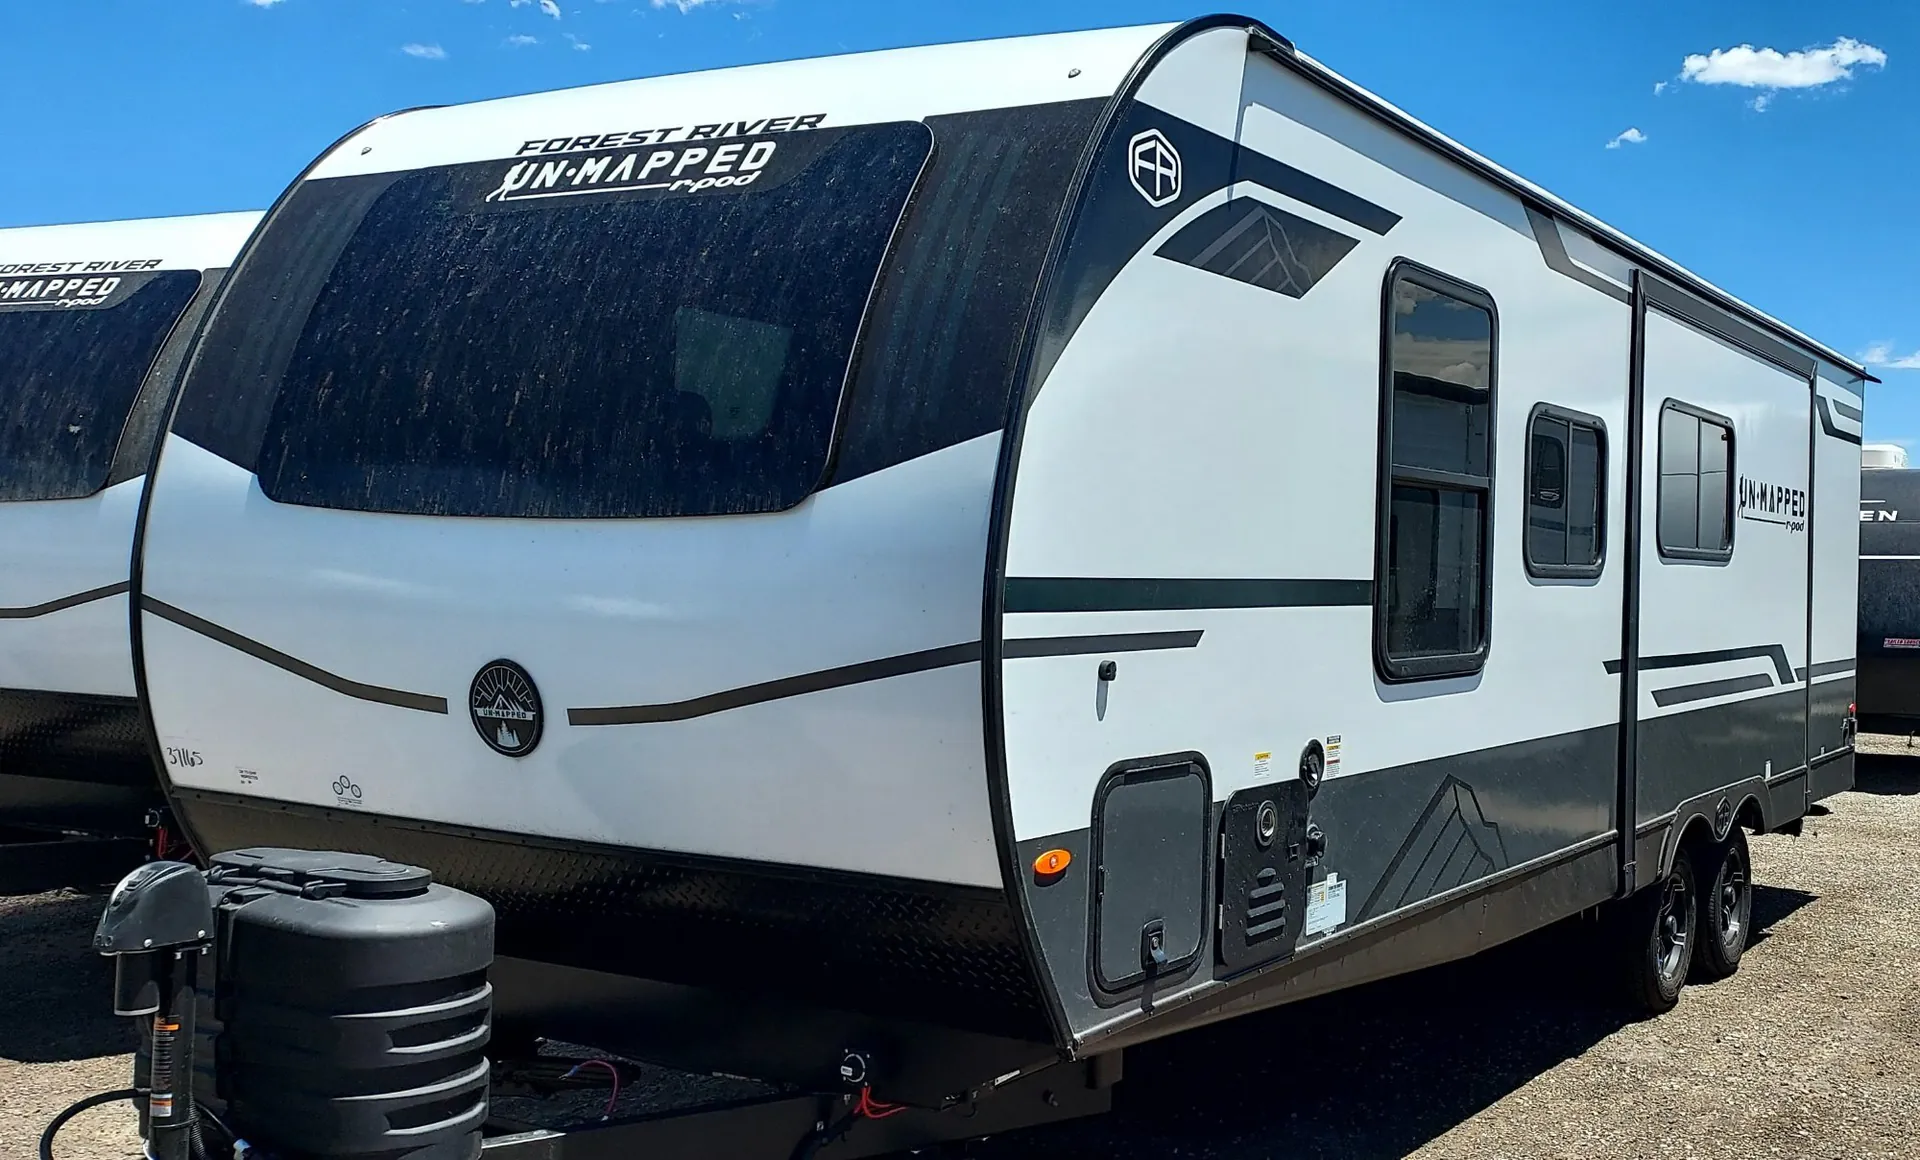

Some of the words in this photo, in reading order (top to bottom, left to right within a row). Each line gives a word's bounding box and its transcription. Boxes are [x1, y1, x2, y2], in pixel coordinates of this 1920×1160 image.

[516, 126, 684, 155] FOREST
[686, 112, 828, 141] RIVER
[0, 261, 84, 274] OREST
[82, 258, 164, 273] RIVER
